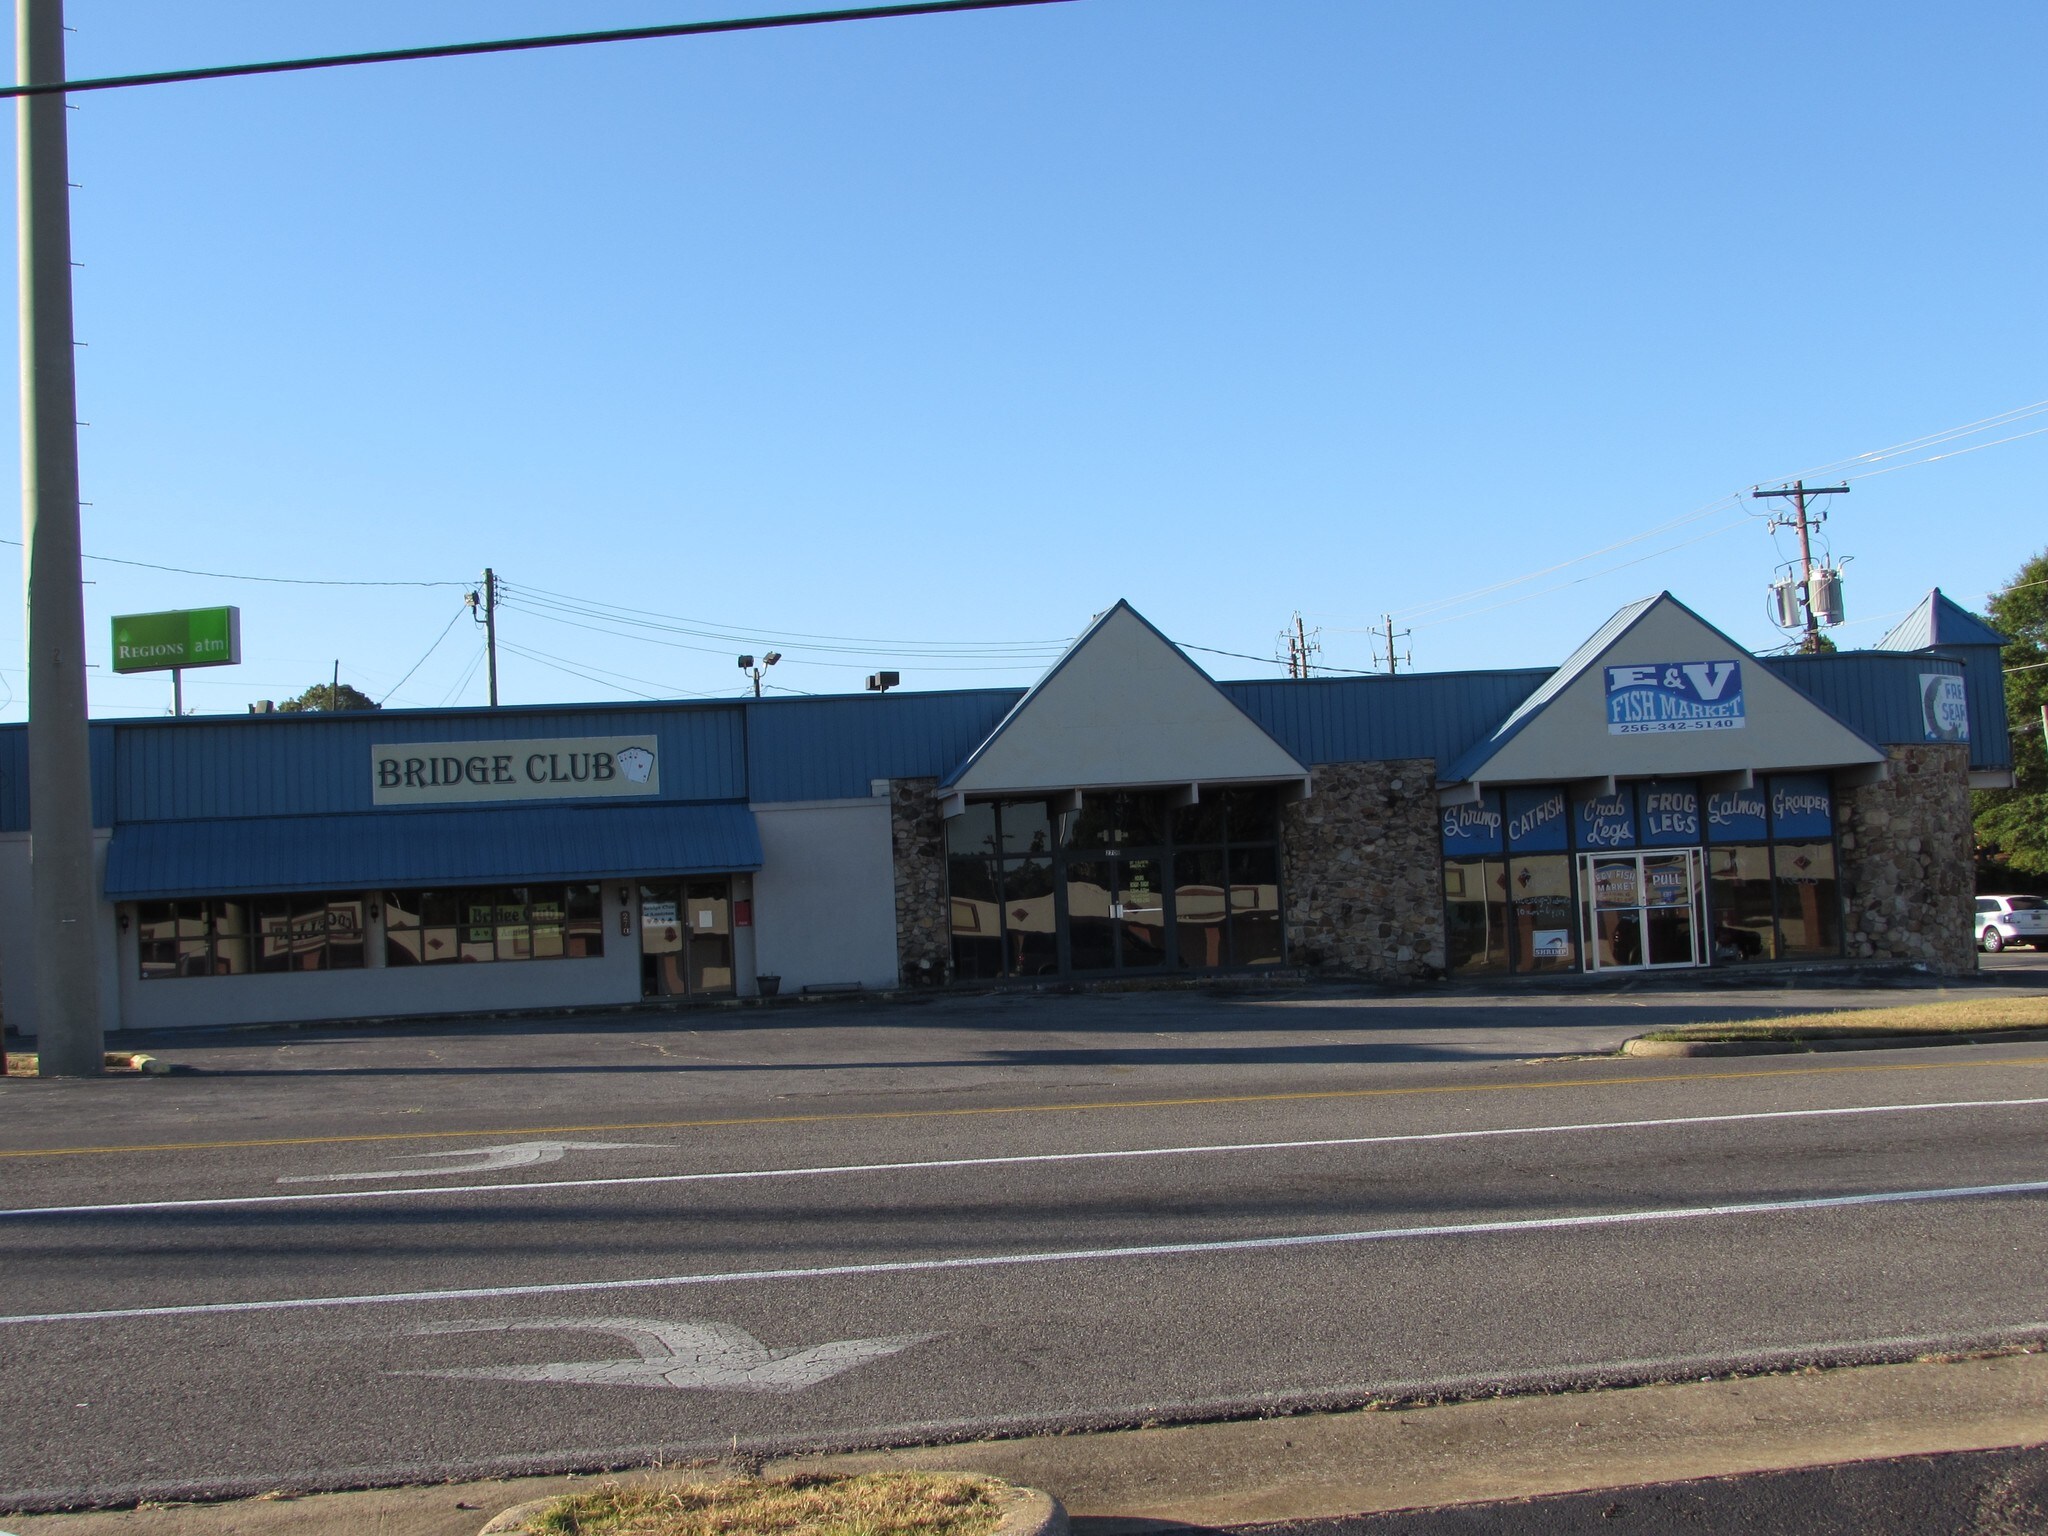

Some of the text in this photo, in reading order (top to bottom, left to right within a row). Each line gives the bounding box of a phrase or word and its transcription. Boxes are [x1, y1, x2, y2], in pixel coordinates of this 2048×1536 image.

[120, 638, 224, 659] REGIONS atm
[1612, 690, 1741, 722] FISH MARKET
[1620, 719, 1733, 733] 256-342-5140
[379, 752, 616, 789] BRIDGE CLUB
[1508, 794, 1564, 840] CATFISH
[1584, 794, 1625, 822] Crab
[1647, 793, 1697, 814] FROG
[1707, 792, 1767, 826] Salmon
[1772, 789, 1830, 819] GROUPER
[1444, 800, 1501, 839] Shrimp
[1586, 818, 1633, 846] Legs
[1649, 814, 1697, 835] LEGS
[1597, 881, 1635, 892] MARKET
[1616, 870, 1636, 882] FISH
[1652, 873, 1681, 886] PULL
